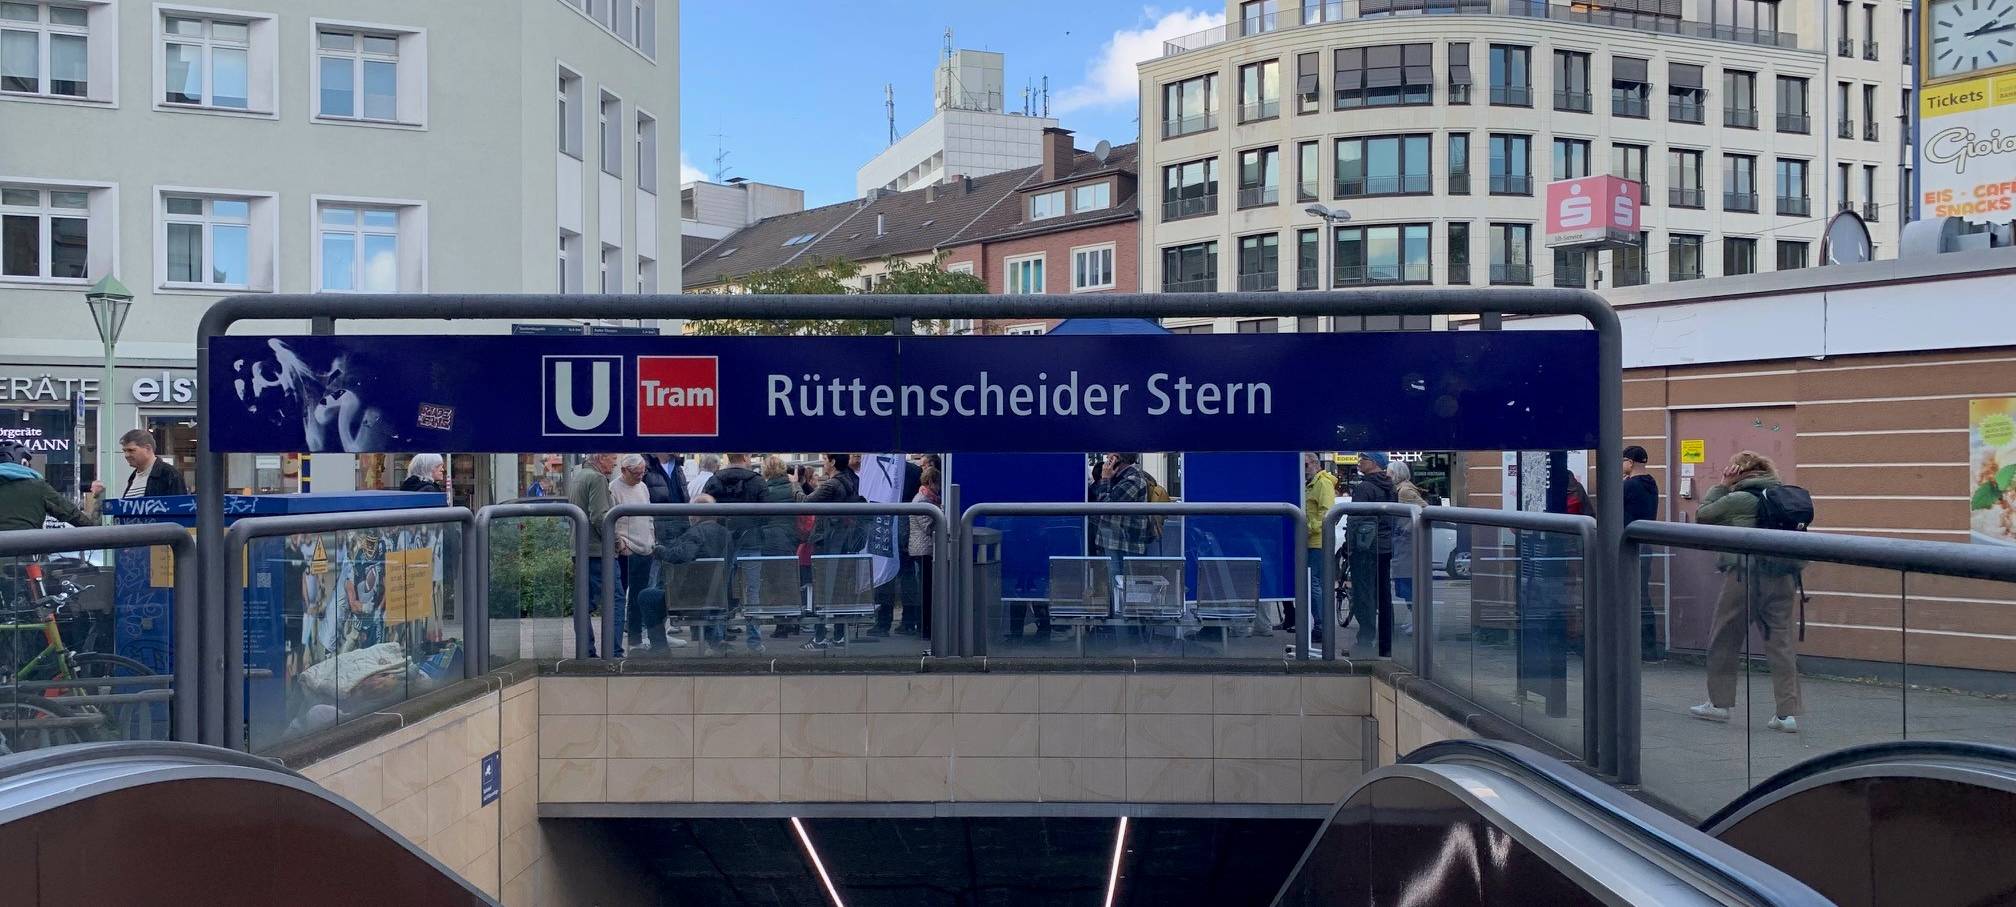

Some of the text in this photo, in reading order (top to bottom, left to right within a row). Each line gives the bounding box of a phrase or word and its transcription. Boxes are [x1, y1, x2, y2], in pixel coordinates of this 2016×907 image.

[1928, 91, 1984, 109] Tickets
[1925, 189, 1953, 204] EIS
[1936, 197, 2011, 217] SNACKS
[555, 361, 1272, 430] U Tram Rüttenscheider Stern
[882, 515, 890, 551] ESSE
